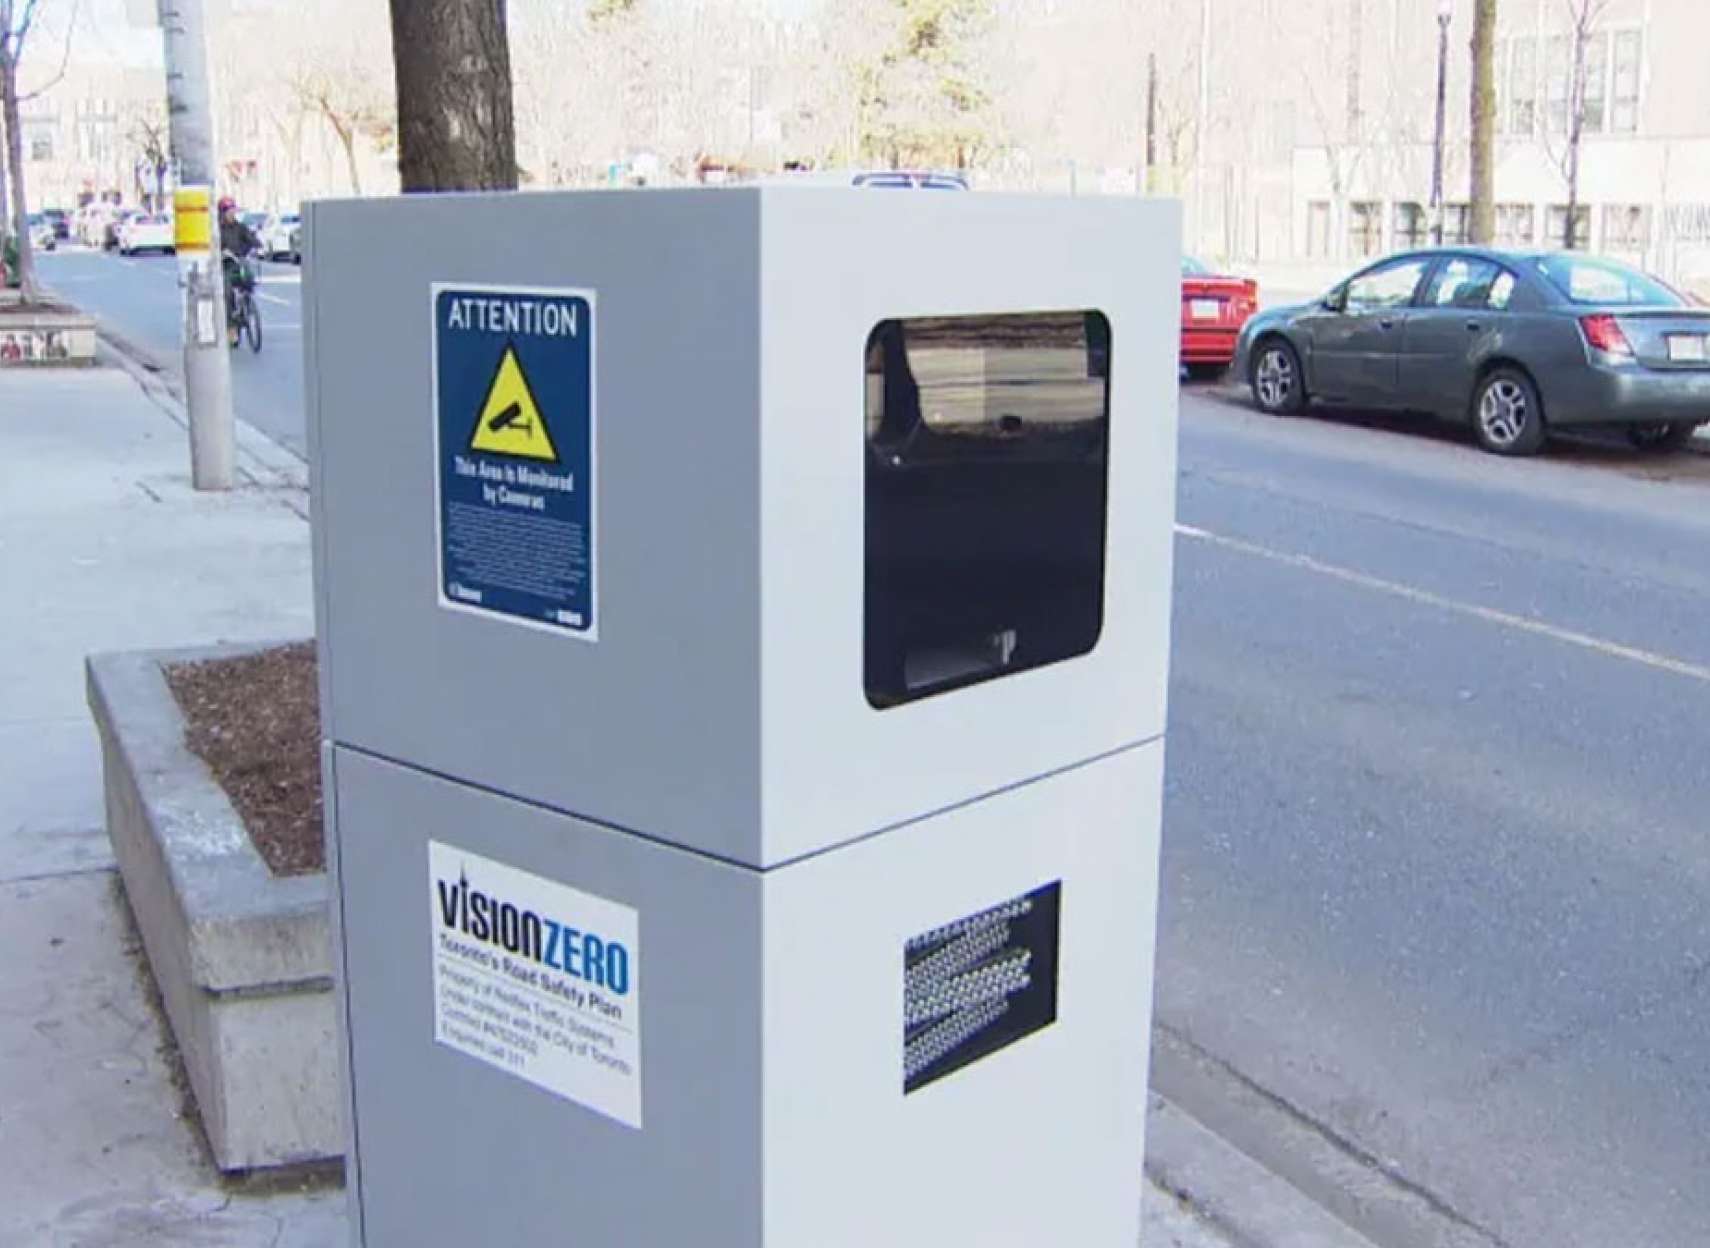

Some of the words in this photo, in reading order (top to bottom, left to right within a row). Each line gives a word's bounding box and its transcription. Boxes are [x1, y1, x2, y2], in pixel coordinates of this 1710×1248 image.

[449, 299, 577, 336] ATTENTION
[455, 456, 476, 476] This
[480, 460, 503, 481] Area
[518, 464, 574, 492] Monitored
[483, 482, 496, 507] by
[499, 484, 545, 510] Cameras
[440, 933, 499, 970] Toronto's
[503, 957, 538, 986] Road
[540, 972, 585, 1008] Safety
[588, 992, 623, 1021] Plan
[439, 964, 479, 995] Property
[483, 983, 492, 996] of
[534, 1003, 564, 1028] Traffic
[567, 1016, 614, 1049] Systems
[512, 1016, 532, 1034] with
[534, 1023, 550, 1040] the
[552, 1031, 573, 1054] City
[575, 1040, 587, 1056] of
[590, 1044, 632, 1076] Toronto
